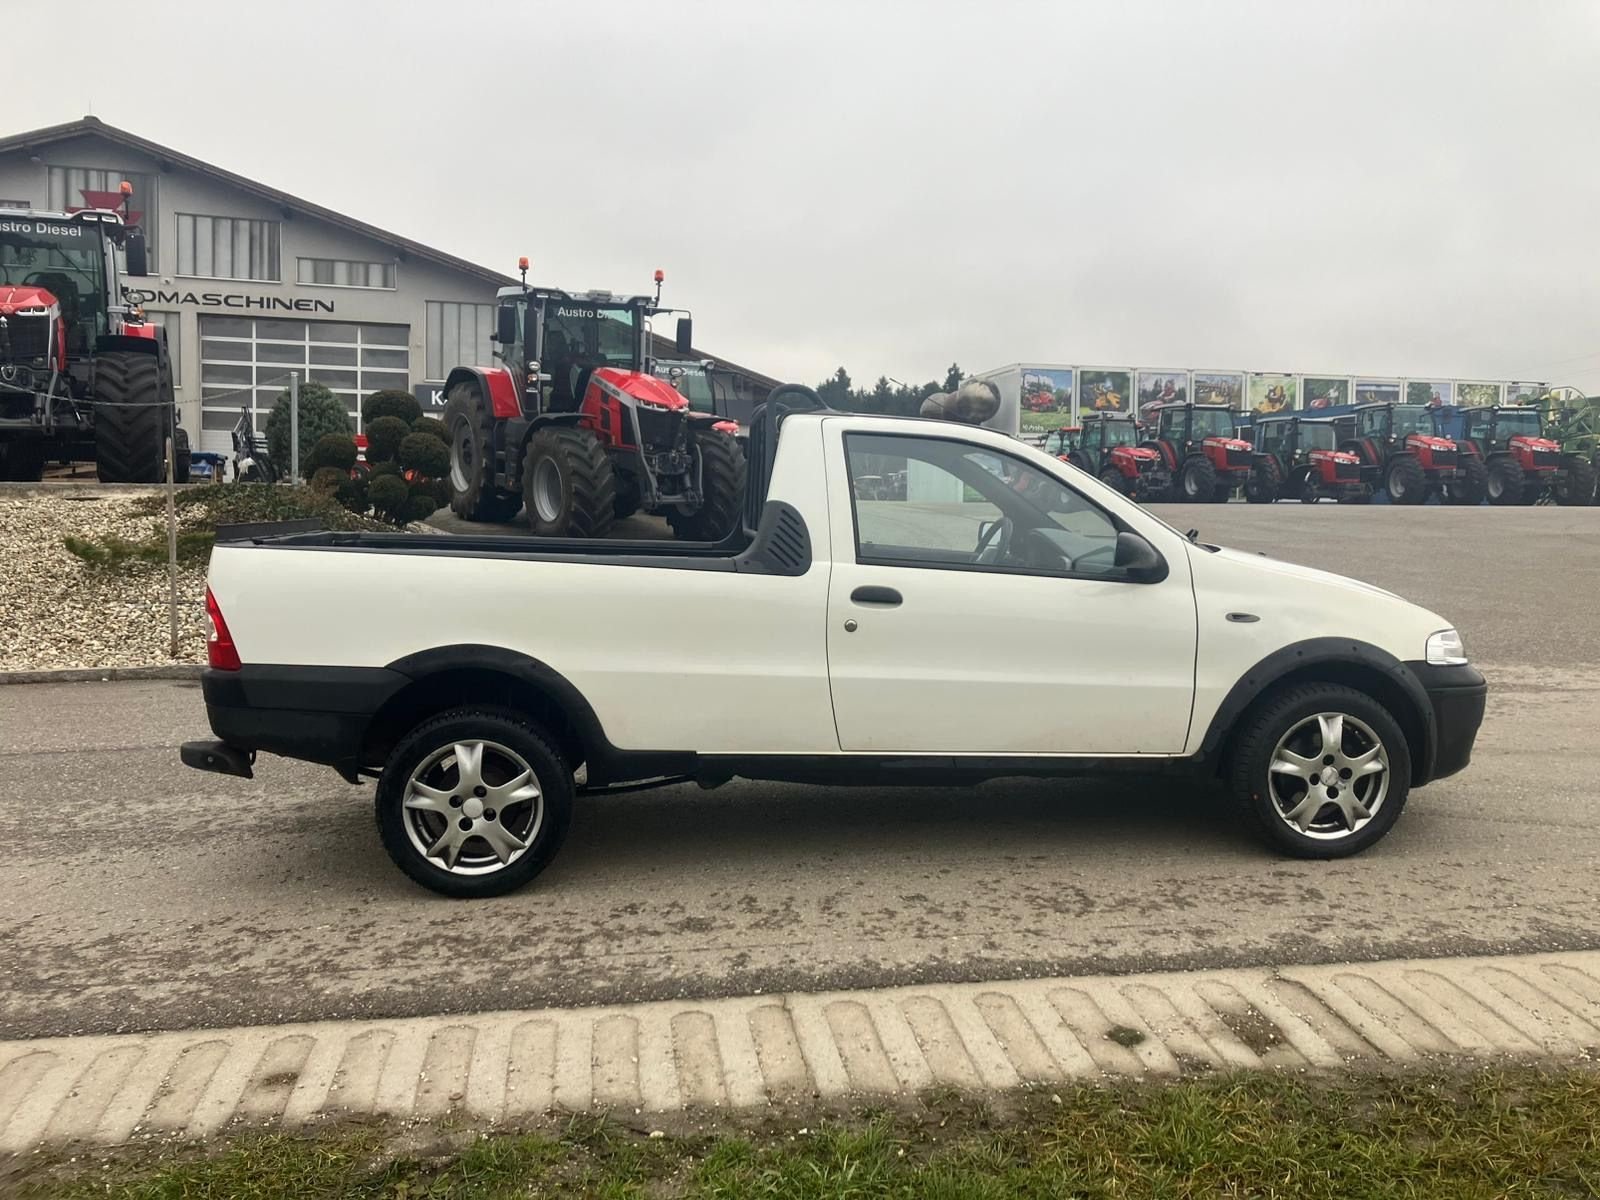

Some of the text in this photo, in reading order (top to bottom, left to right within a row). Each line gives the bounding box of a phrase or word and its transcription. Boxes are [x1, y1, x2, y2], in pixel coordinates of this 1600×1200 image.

[0, 222, 82, 237] stro Diesel
[121, 288, 335, 312] DMASCHINEN
[557, 306, 594, 318] Austro
[431, 390, 448, 406] K
